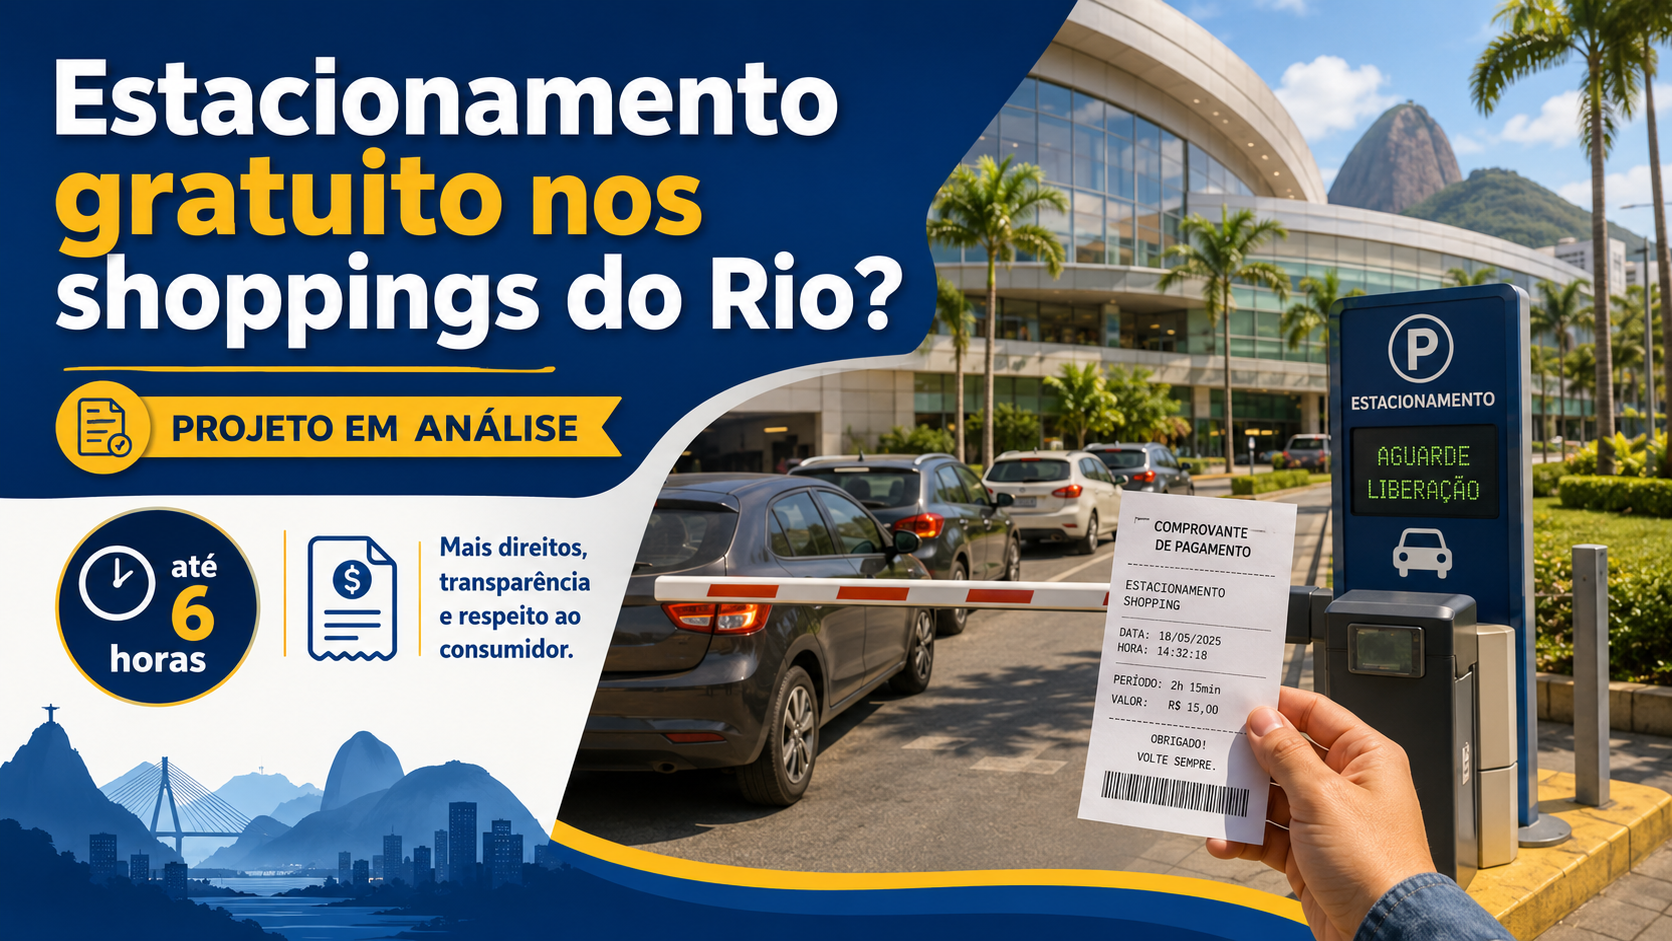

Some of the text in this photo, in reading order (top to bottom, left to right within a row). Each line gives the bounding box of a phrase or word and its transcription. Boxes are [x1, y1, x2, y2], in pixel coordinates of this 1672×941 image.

[1407, 328, 1439, 371] P
[1352, 392, 1494, 410] ESTACIONAMENTO
[1378, 446, 1469, 465] AGUARDE
[1368, 475, 1479, 504] LIBERAÇÃO
[1154, 520, 1248, 539] COMPROVANTE
[1155, 538, 1251, 558] DE PAGAMENTO
[1125, 579, 1226, 598] ESTACIONAMENTO
[1123, 596, 1181, 611] SHOPPING
[1119, 627, 1222, 646] DATA: 18/05/2025
[1117, 642, 1208, 660] HORA: 14:32:18
[1170, 680, 1184, 691] 2h
[1190, 682, 1221, 695] 15min
[1111, 693, 1219, 716] VALOR: R$ 15,00
[1150, 733, 1206, 750] OBRIGADO!
[1137, 751, 1216, 771] VOLTE SEMPRE.
